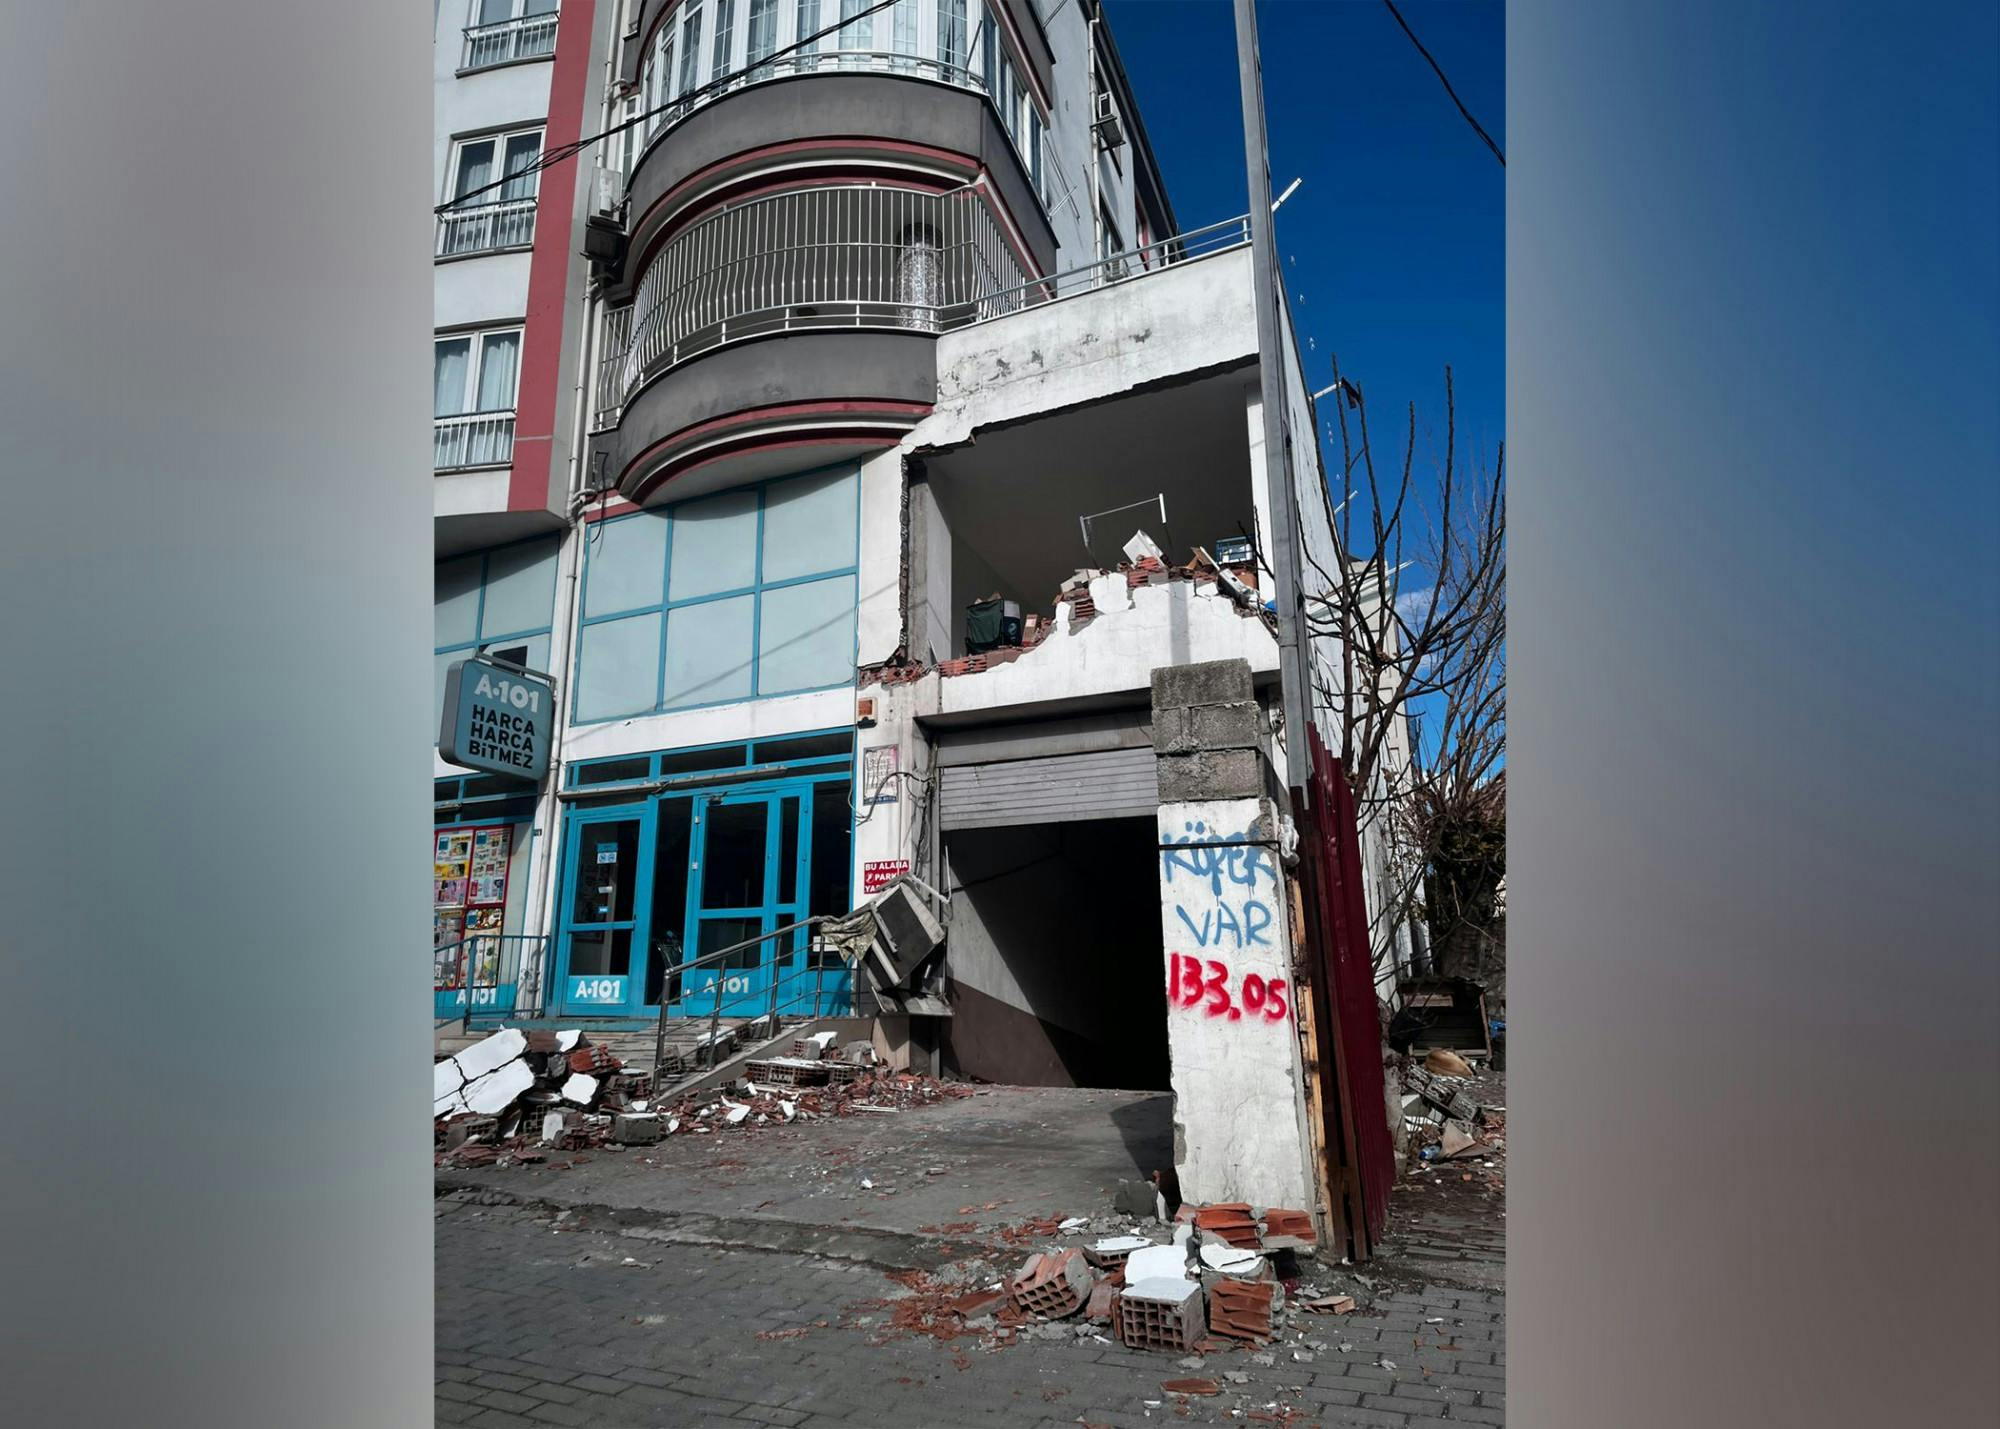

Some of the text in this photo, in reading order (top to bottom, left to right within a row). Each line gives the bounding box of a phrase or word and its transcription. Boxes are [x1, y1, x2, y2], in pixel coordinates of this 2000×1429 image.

[472, 704, 535, 737] HARCA
[470, 721, 534, 753] HARCA
[865, 863, 877, 871] BU
[874, 873, 897, 881] PARK
[1176, 901, 1272, 949] VAR
